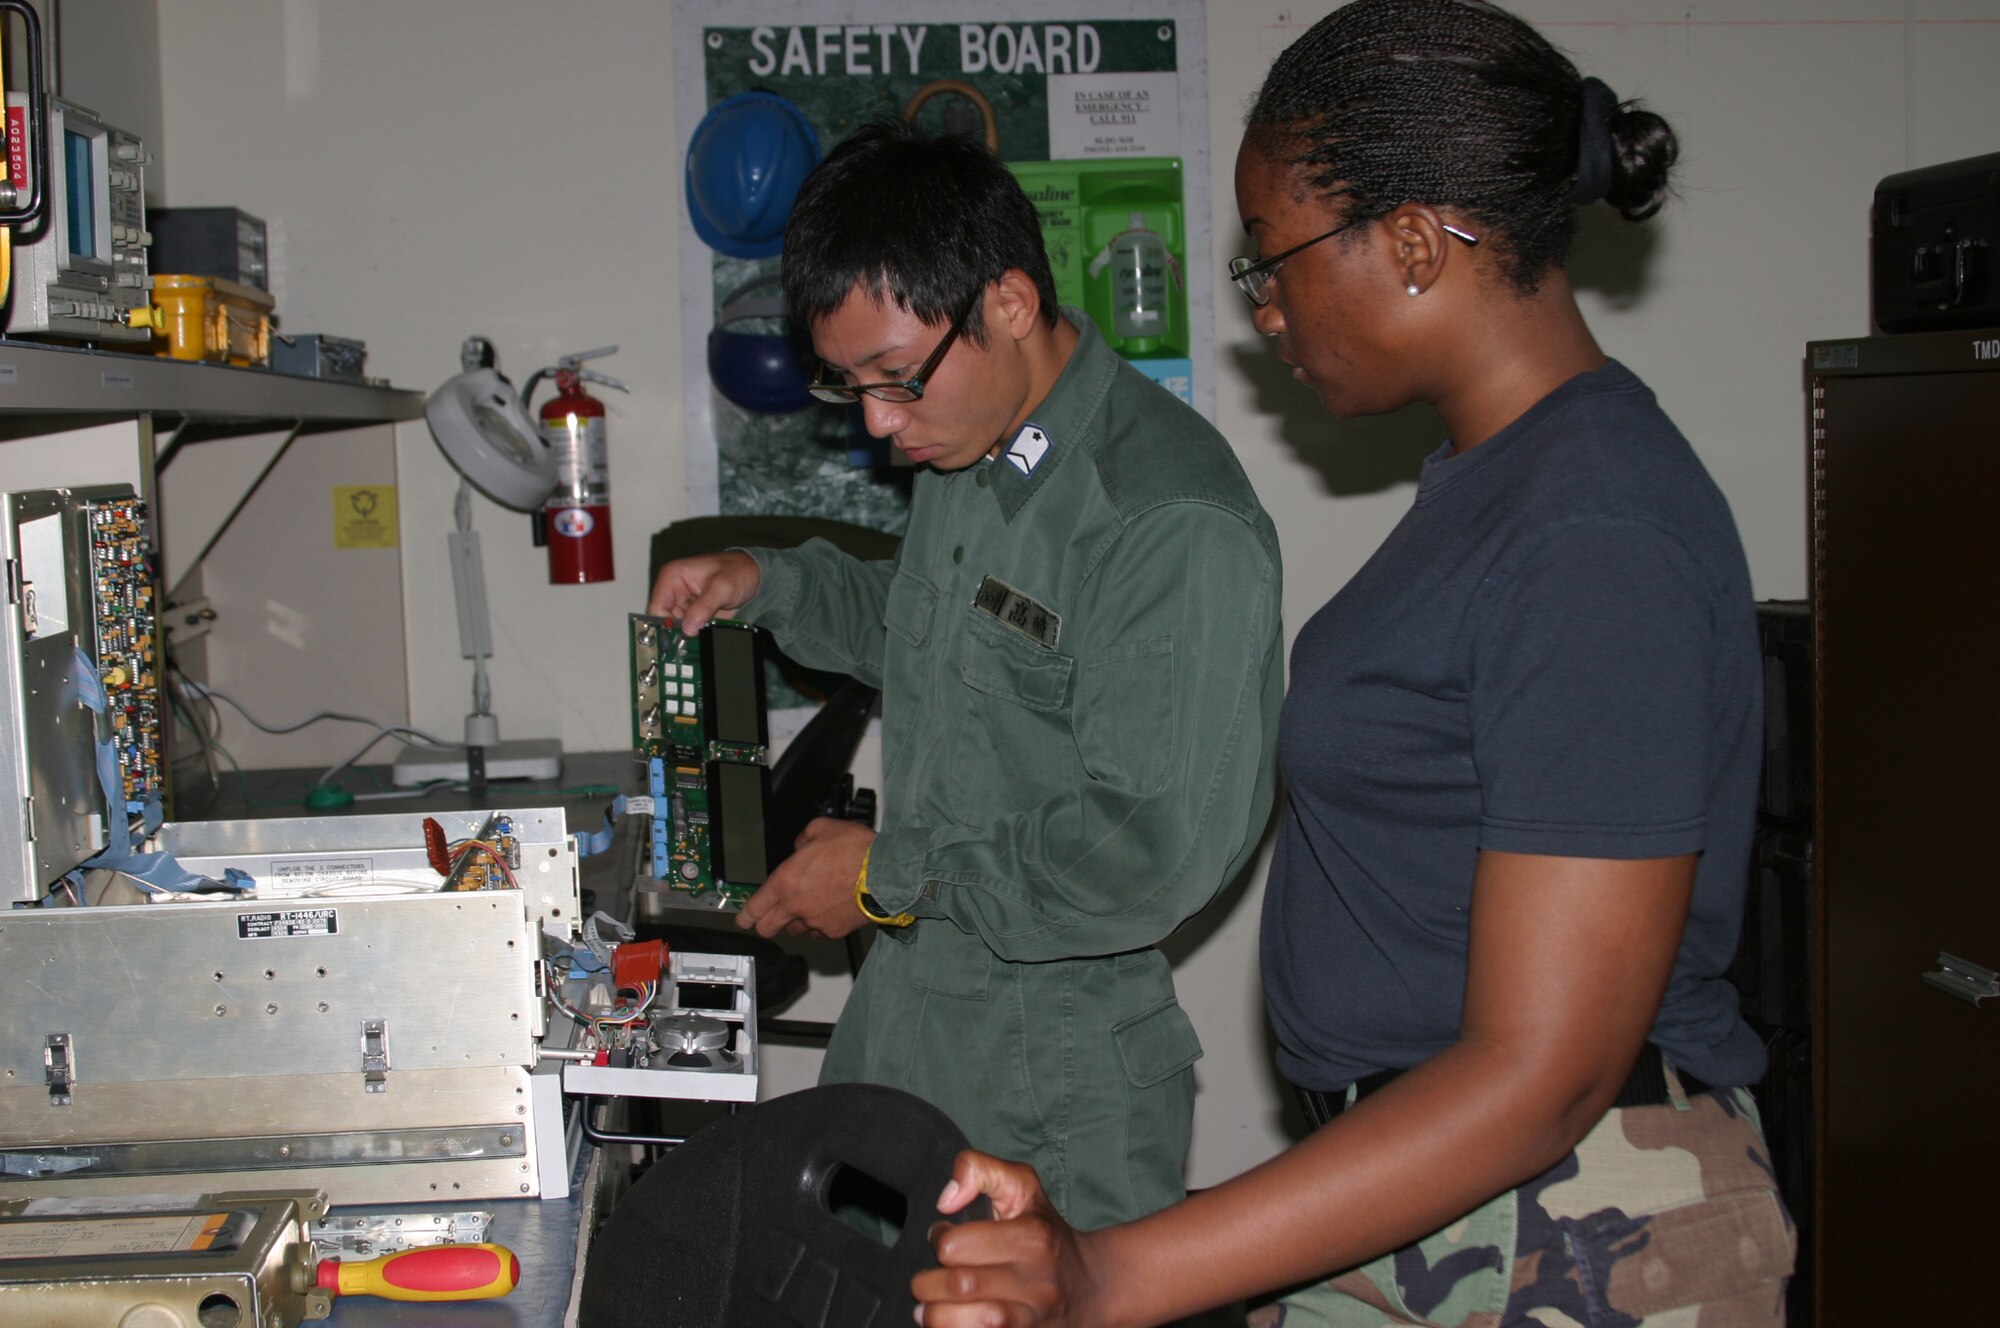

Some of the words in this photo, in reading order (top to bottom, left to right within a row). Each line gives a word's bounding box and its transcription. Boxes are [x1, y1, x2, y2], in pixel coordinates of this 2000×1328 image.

[748, 25, 927, 76] SAFETY
[960, 23, 1102, 74] BOARD
[1075, 91, 1086, 101] IN
[1088, 91, 1114, 101] CASE
[1118, 91, 1132, 101] OF
[1135, 90, 1150, 100] AN
[1075, 102, 1141, 112] EMERGENCY
[1090, 114, 1118, 124] CALL
[1120, 114, 1136, 124] 911
[280, 911, 334, 920] RT-1446/URC
